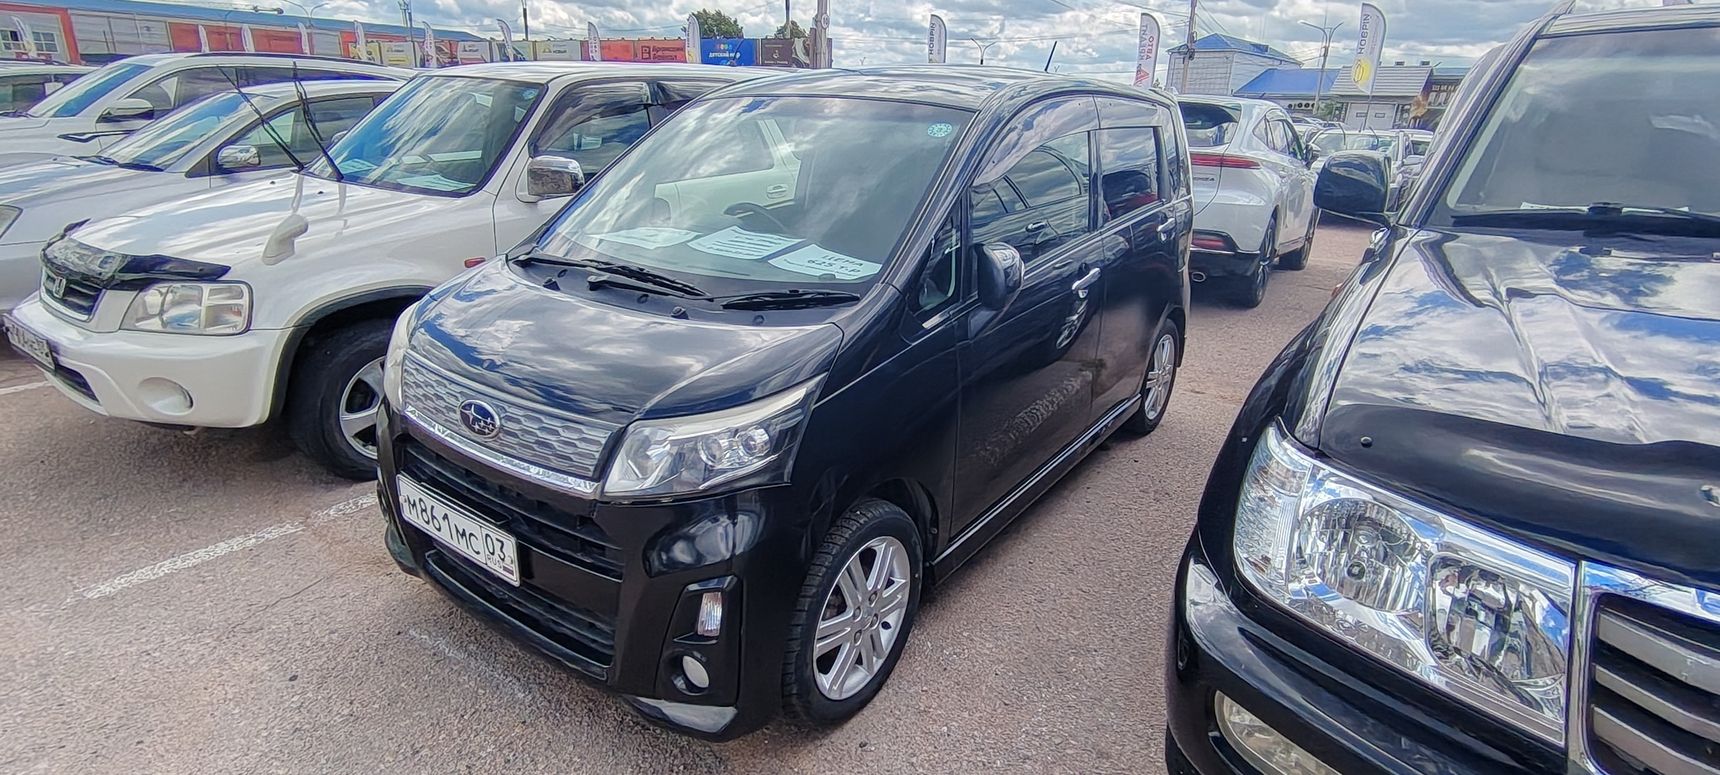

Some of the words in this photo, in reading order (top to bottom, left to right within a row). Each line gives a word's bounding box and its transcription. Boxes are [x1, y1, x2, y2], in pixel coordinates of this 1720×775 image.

[807, 259, 835, 268] 625
[822, 255, 864, 267] ЦЕНА
[485, 533, 506, 562] 03
[487, 554, 503, 570] RUS
